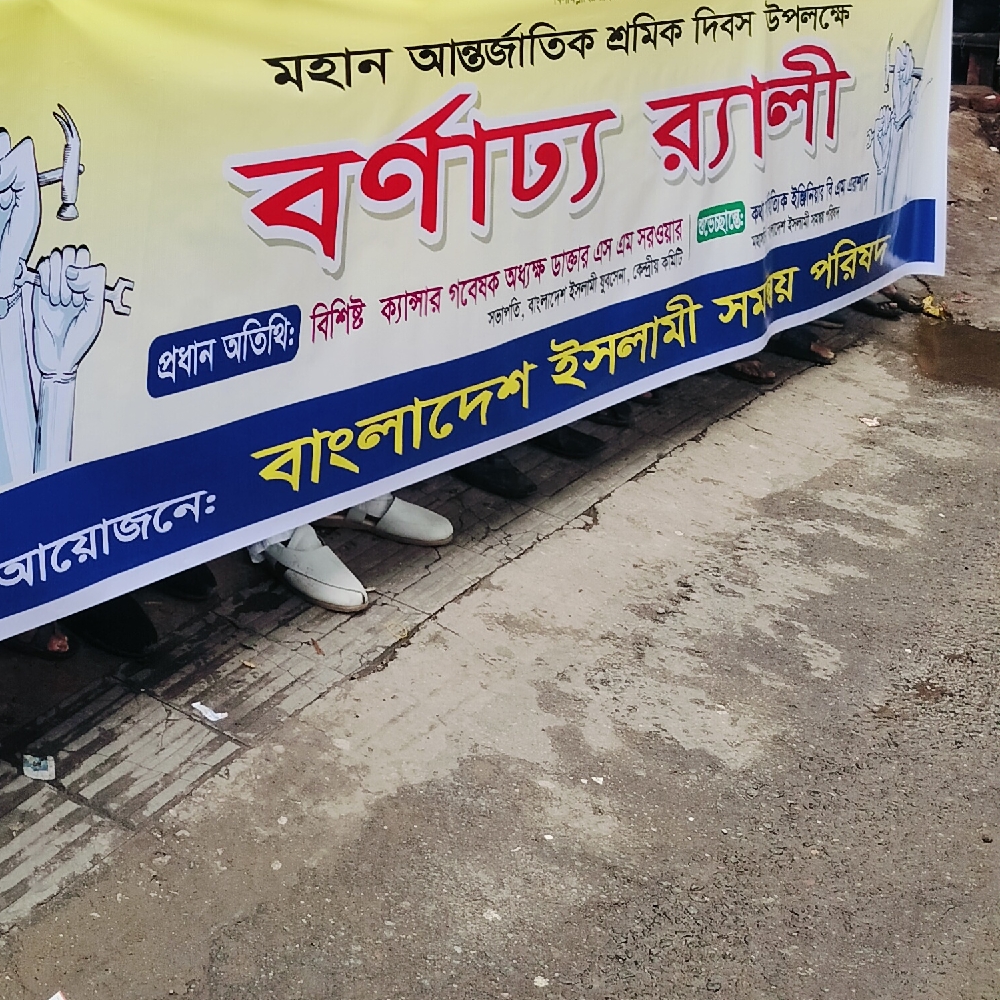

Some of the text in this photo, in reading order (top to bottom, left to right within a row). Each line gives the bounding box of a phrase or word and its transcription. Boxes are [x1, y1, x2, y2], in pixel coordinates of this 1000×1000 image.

[262, 0, 854, 91] মহান আন্তর্জাতিক শ্রমিক দিবস উপলক্ষে
[230, 45, 852, 260] বর্ণাঢ্য র‍্যালী
[157, 338, 218, 384] প্রধান
[309, 294, 367, 343] বিশিষ্ট
[379, 285, 443, 326] ক্যান্সার
[448, 270, 500, 309] গবেষক
[504, 258, 547, 291] অধ্যক্ষ
[550, 244, 591, 278] ডাক্তার
[594, 238, 613, 262] এস
[616, 231, 635, 258] এম
[637, 218, 684, 250] সরওয়ার
[527, 247, 684, 316] বাংলাদেশ ইসলামী কেন্দ্রীয় কমিটি
[250, 361, 538, 492] বাংলাদেশ
[547, 293, 704, 390] ইসলামী
[810, 238, 892, 290] পরিষদ
